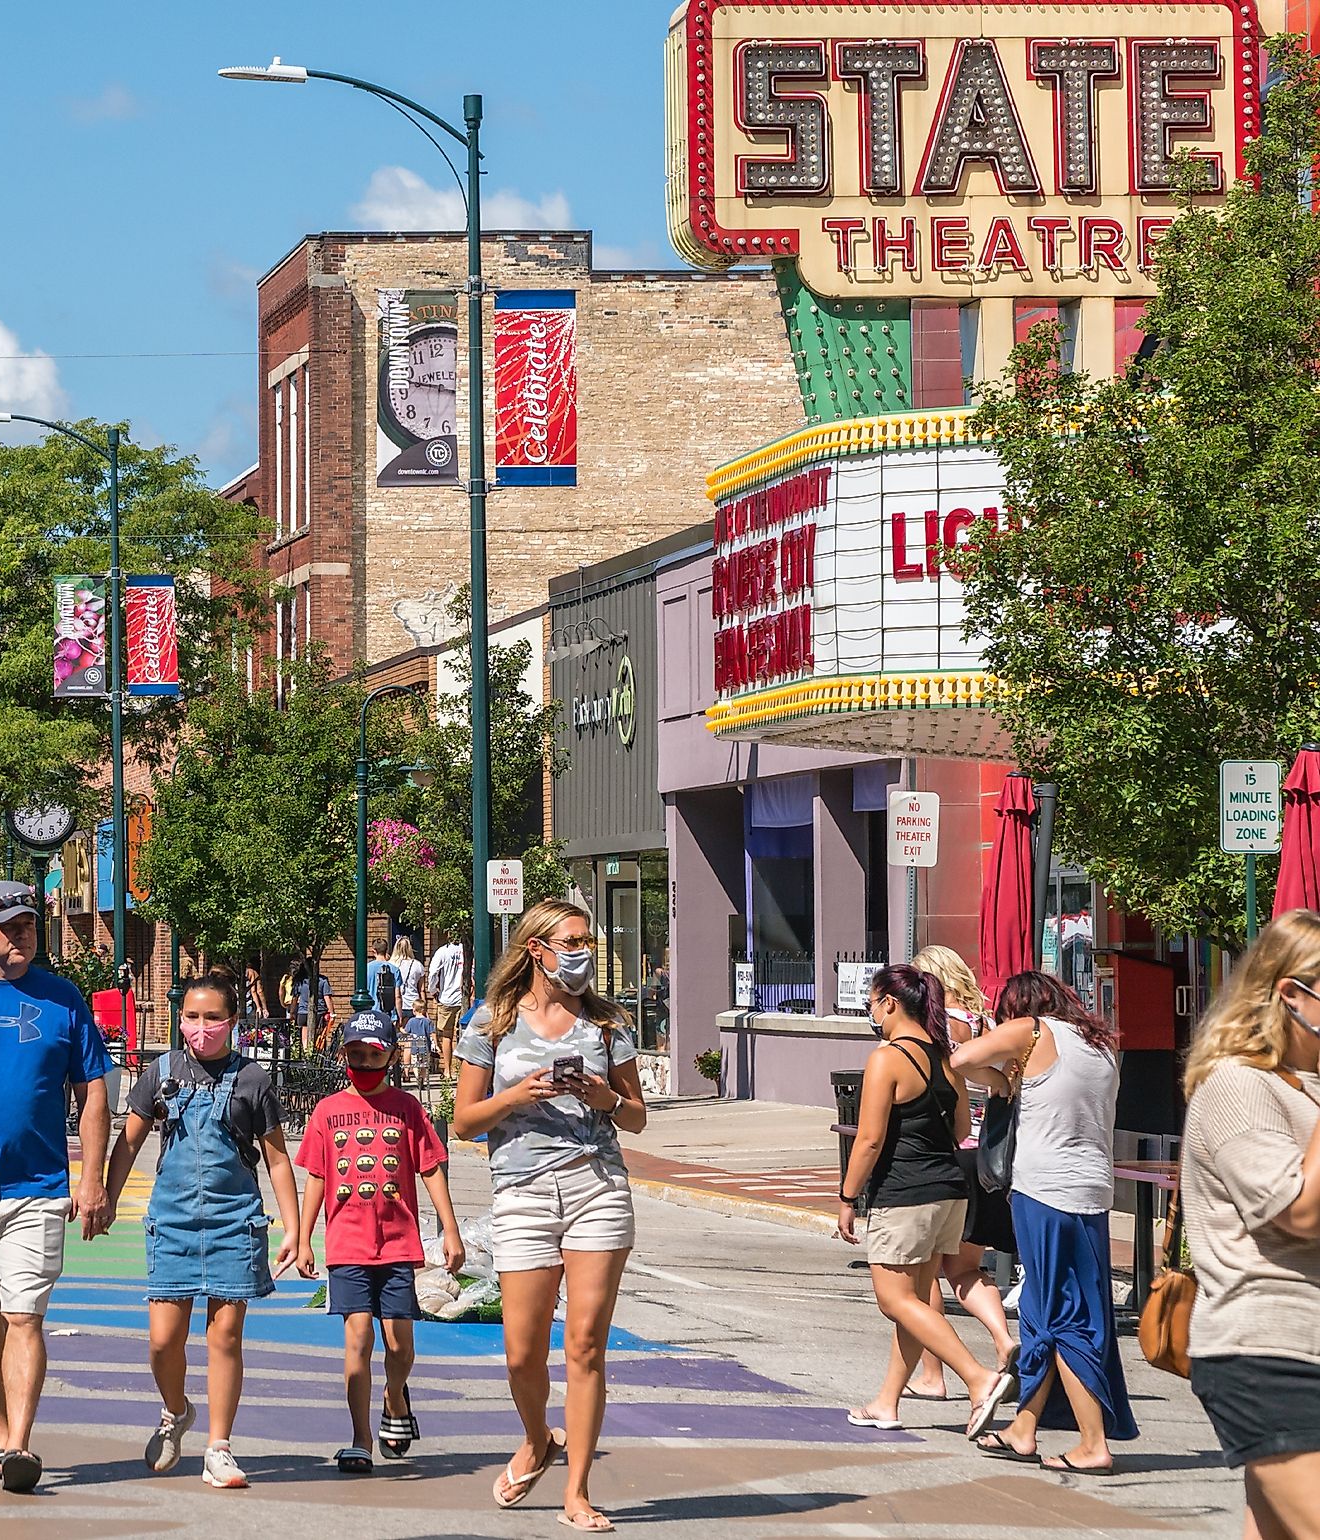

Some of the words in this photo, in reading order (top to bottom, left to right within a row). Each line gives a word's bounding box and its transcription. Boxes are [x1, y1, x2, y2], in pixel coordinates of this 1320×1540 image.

[734, 38, 1223, 196] STATE
[822, 217, 1174, 272] THEATRE
[389, 303, 409, 389] DOWNTOWN
[429, 343, 444, 358] 12
[412, 350, 424, 365] 11
[419, 371, 457, 383] JEWELE
[523, 313, 548, 464] Celebrate!
[406, 405, 416, 419] 8
[424, 417, 431, 428] 7
[60, 584, 74, 636] DOWNTOWN
[144, 589, 161, 682] Celebrate!
[1245, 774, 1256, 785] 15
[1230, 792, 1272, 803] MINUTE
[909, 803, 920, 812] NO
[1226, 810, 1276, 821] LOADING
[897, 816, 931, 827] PARKING
[38, 828, 43, 836] 6
[49, 825, 54, 834] 5
[1236, 828, 1267, 839] ZONE
[896, 831, 931, 841] THEATER
[904, 846, 921, 855] EXIT
[373, 1111, 407, 1125] NINJA
